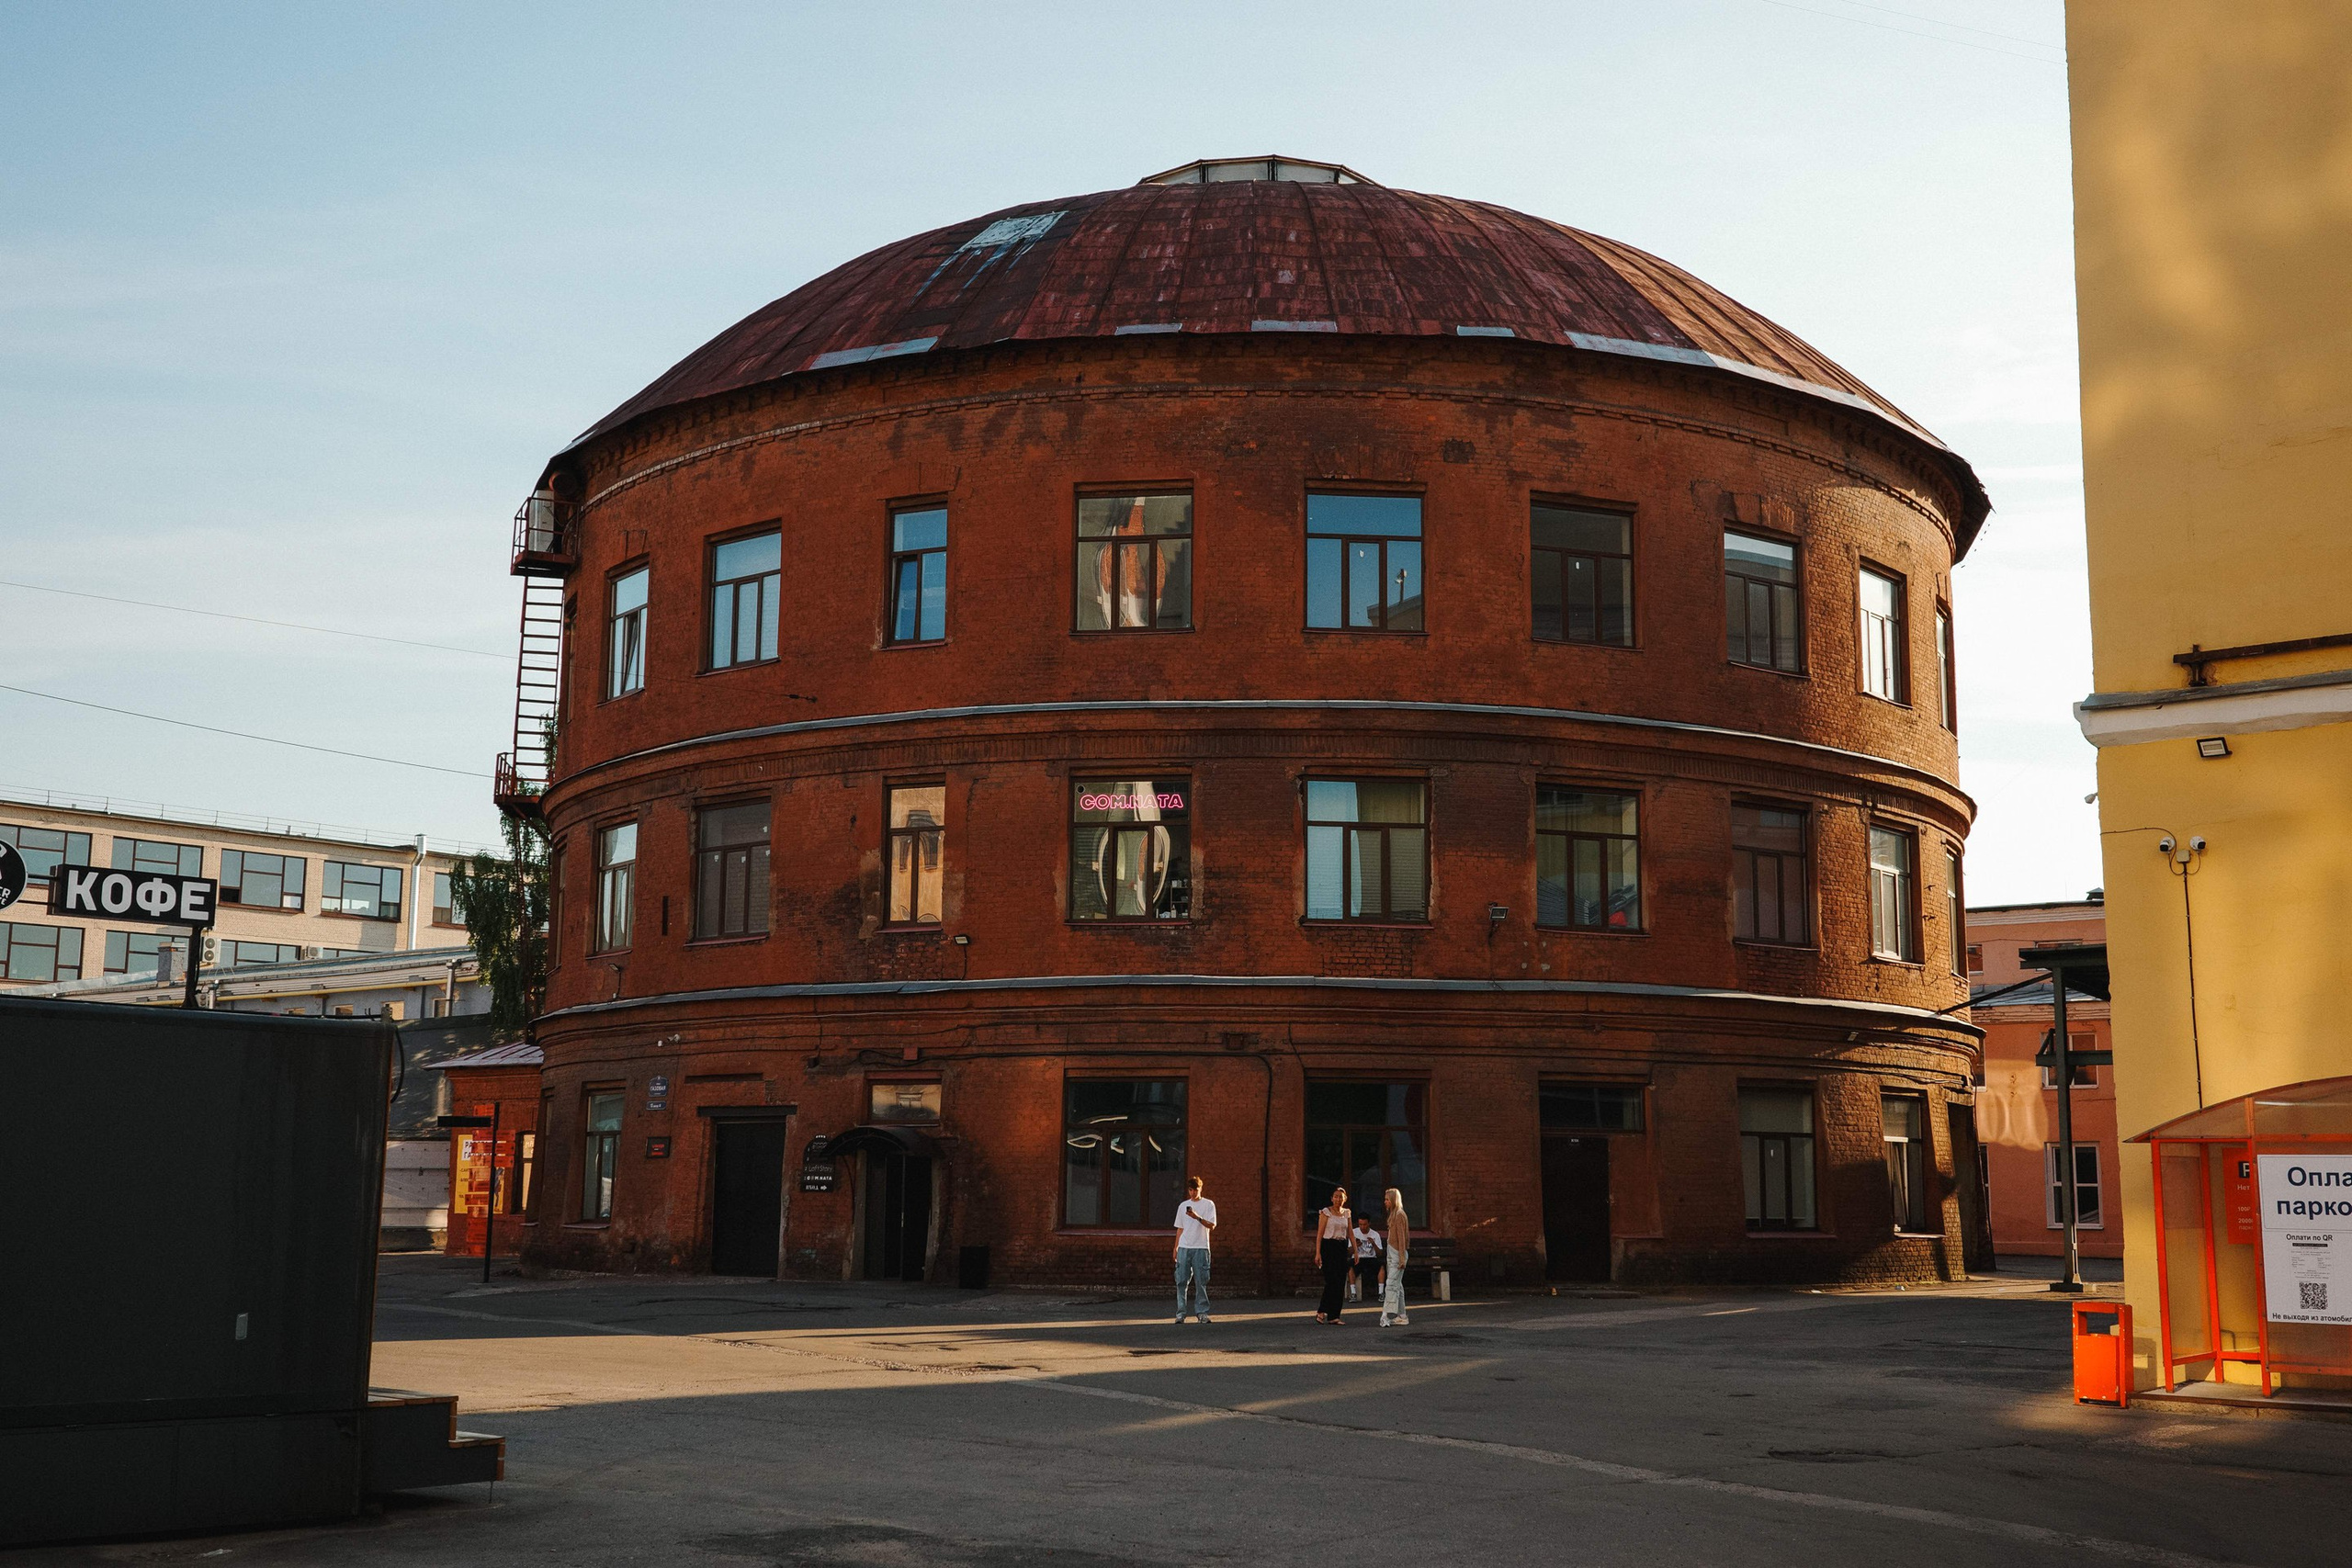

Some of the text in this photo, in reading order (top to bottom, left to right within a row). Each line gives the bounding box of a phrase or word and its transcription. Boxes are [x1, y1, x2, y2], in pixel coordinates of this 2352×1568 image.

[1080, 794, 1183, 810] COM.NATA
[66, 869, 211, 920] КОФЕ
[2288, 1167, 2352, 1186] Опла
[2277, 1200, 2352, 1220] парко
